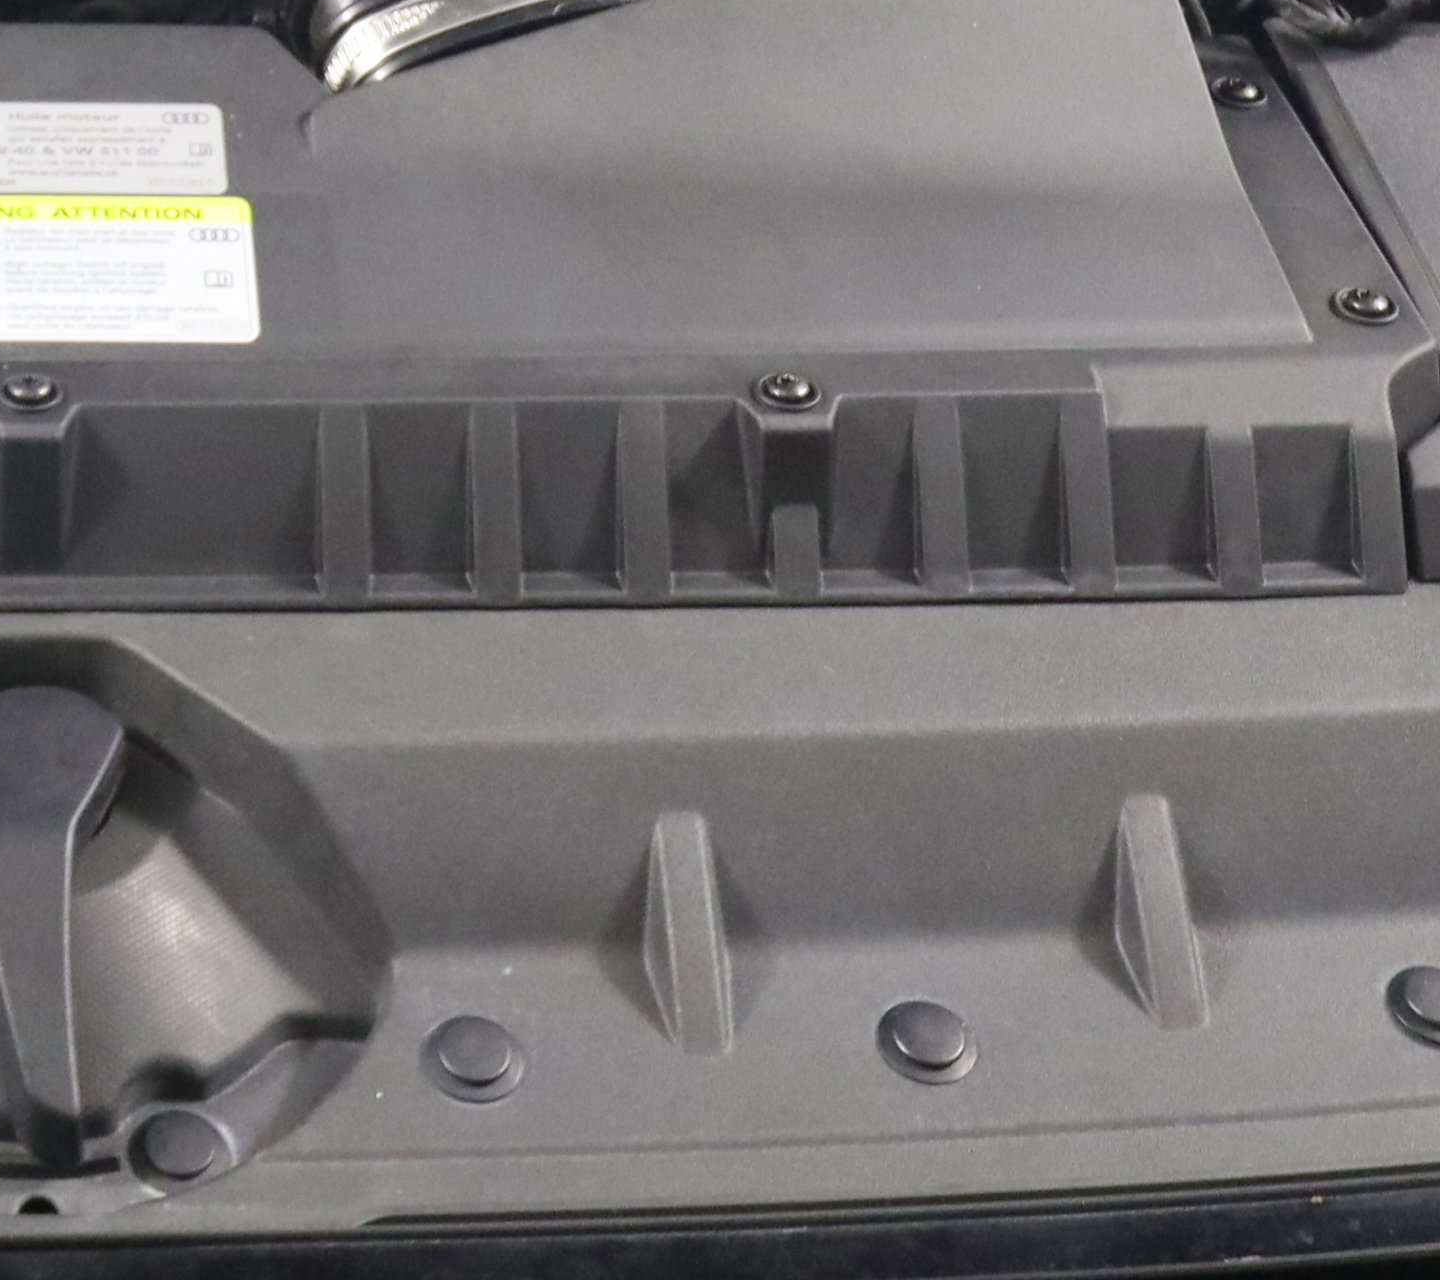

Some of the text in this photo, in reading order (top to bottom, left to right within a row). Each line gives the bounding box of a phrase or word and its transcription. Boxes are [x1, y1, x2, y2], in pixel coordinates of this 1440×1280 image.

[56, 113, 119, 121] moteur
[62, 146, 94, 155] VW
[52, 206, 202, 220] ATTENTION
